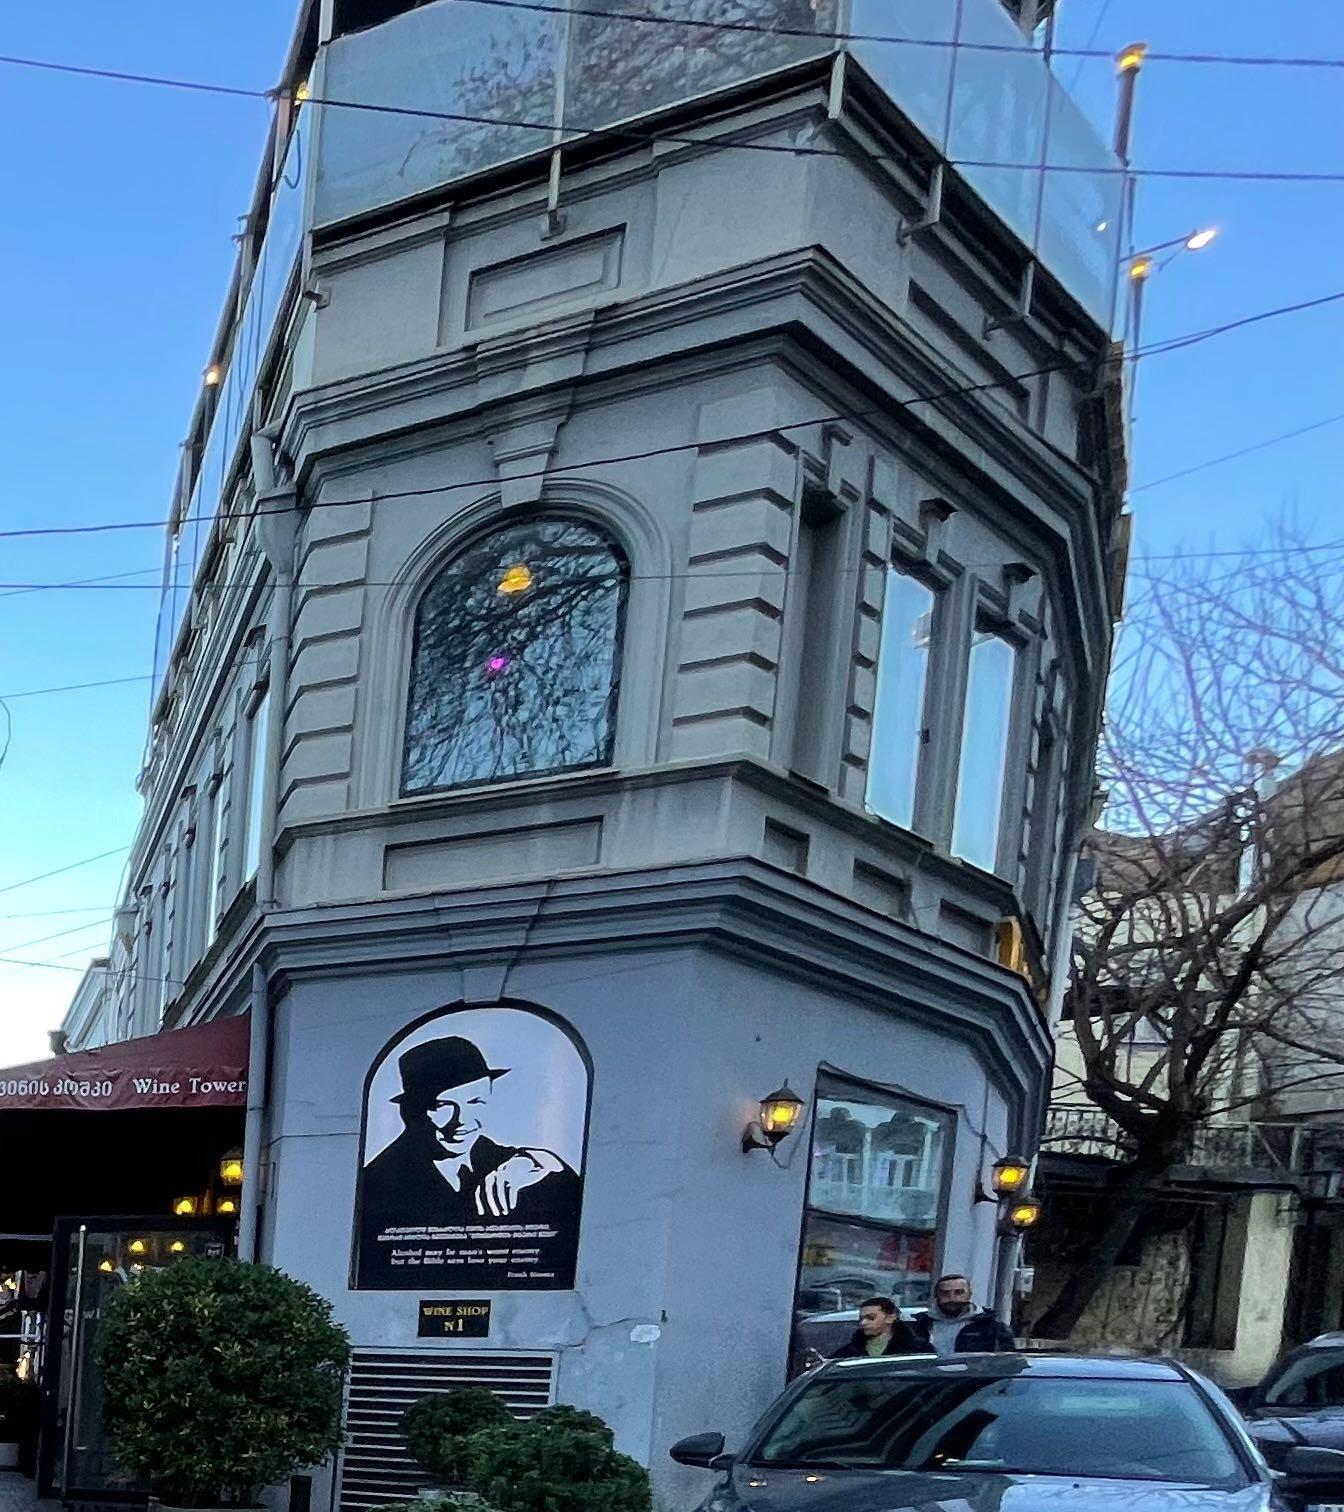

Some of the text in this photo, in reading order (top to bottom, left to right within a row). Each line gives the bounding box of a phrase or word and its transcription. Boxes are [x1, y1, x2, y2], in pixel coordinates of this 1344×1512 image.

[53, 1080, 113, 1097] კოშკი
[132, 1078, 180, 1095] Wine
[188, 1078, 247, 1094] Tower
[423, 1306, 488, 1316] WINE SHOP
